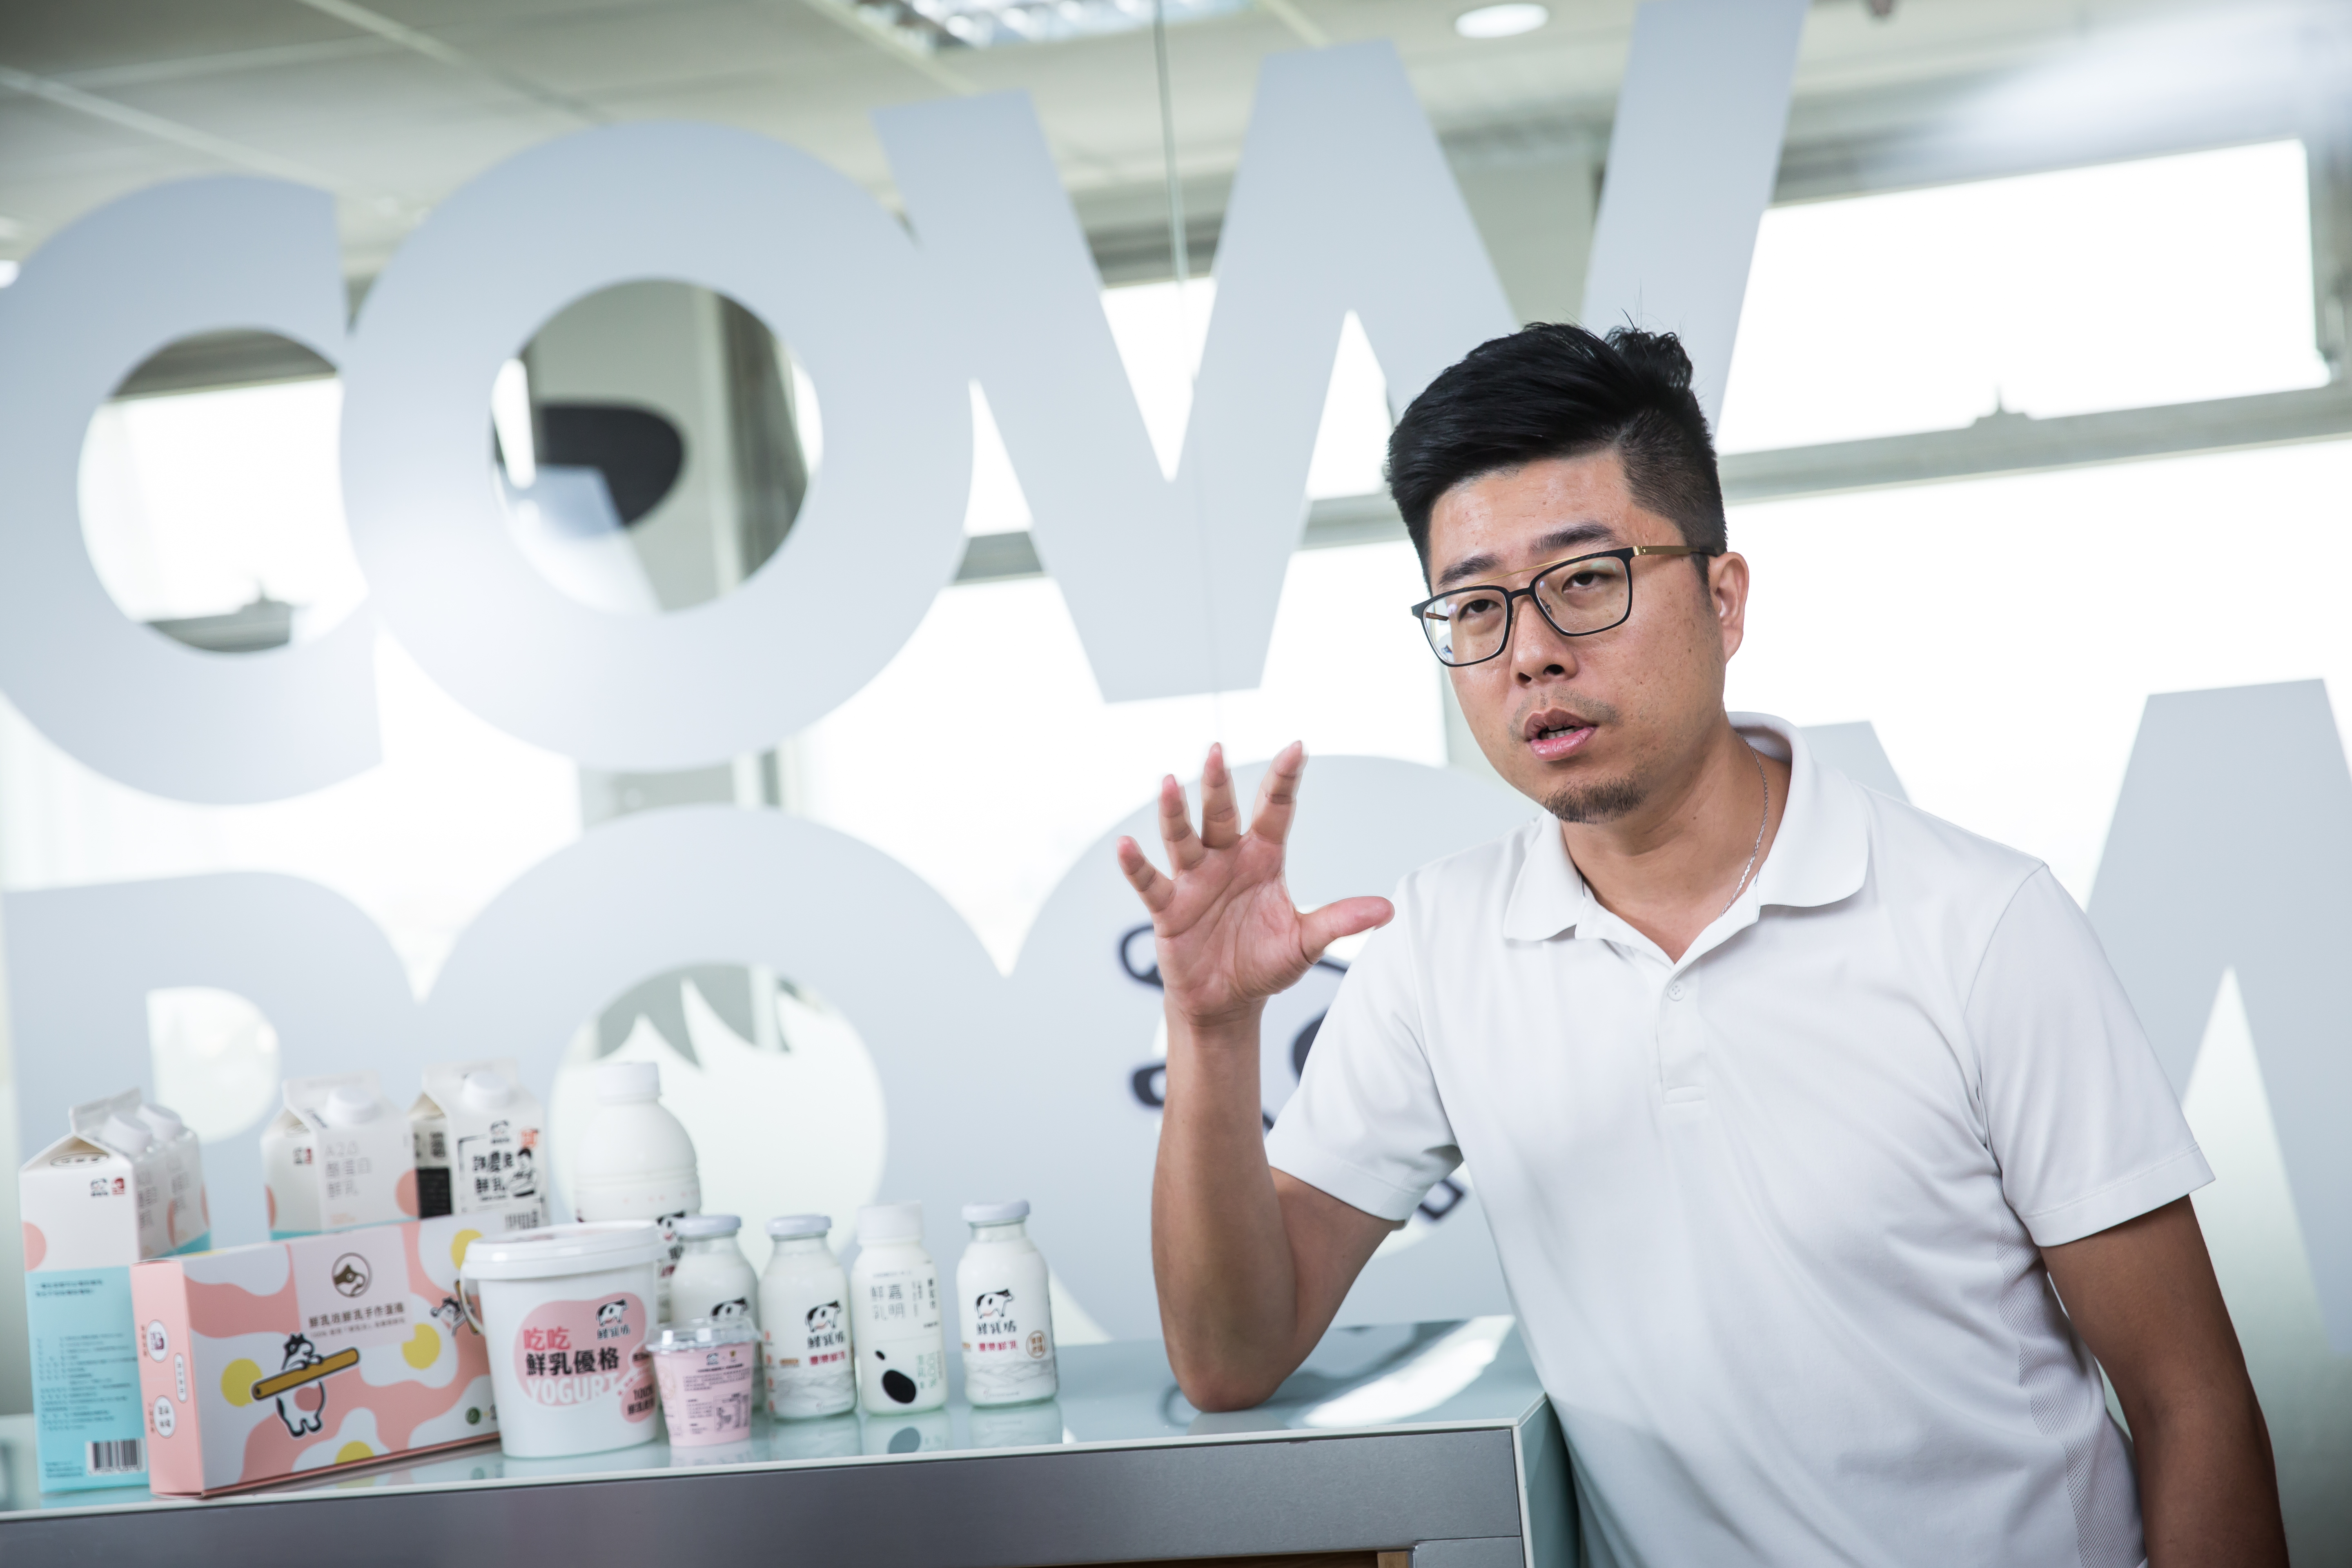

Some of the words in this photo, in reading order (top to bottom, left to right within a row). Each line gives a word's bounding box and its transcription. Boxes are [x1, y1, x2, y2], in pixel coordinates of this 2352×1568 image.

[0, 0, 1807, 805] COW
[523, 1327, 571, 1350] 吃吃
[526, 1346, 619, 1376] 鮮乳優格
[527, 1372, 619, 1405] YOGURT
